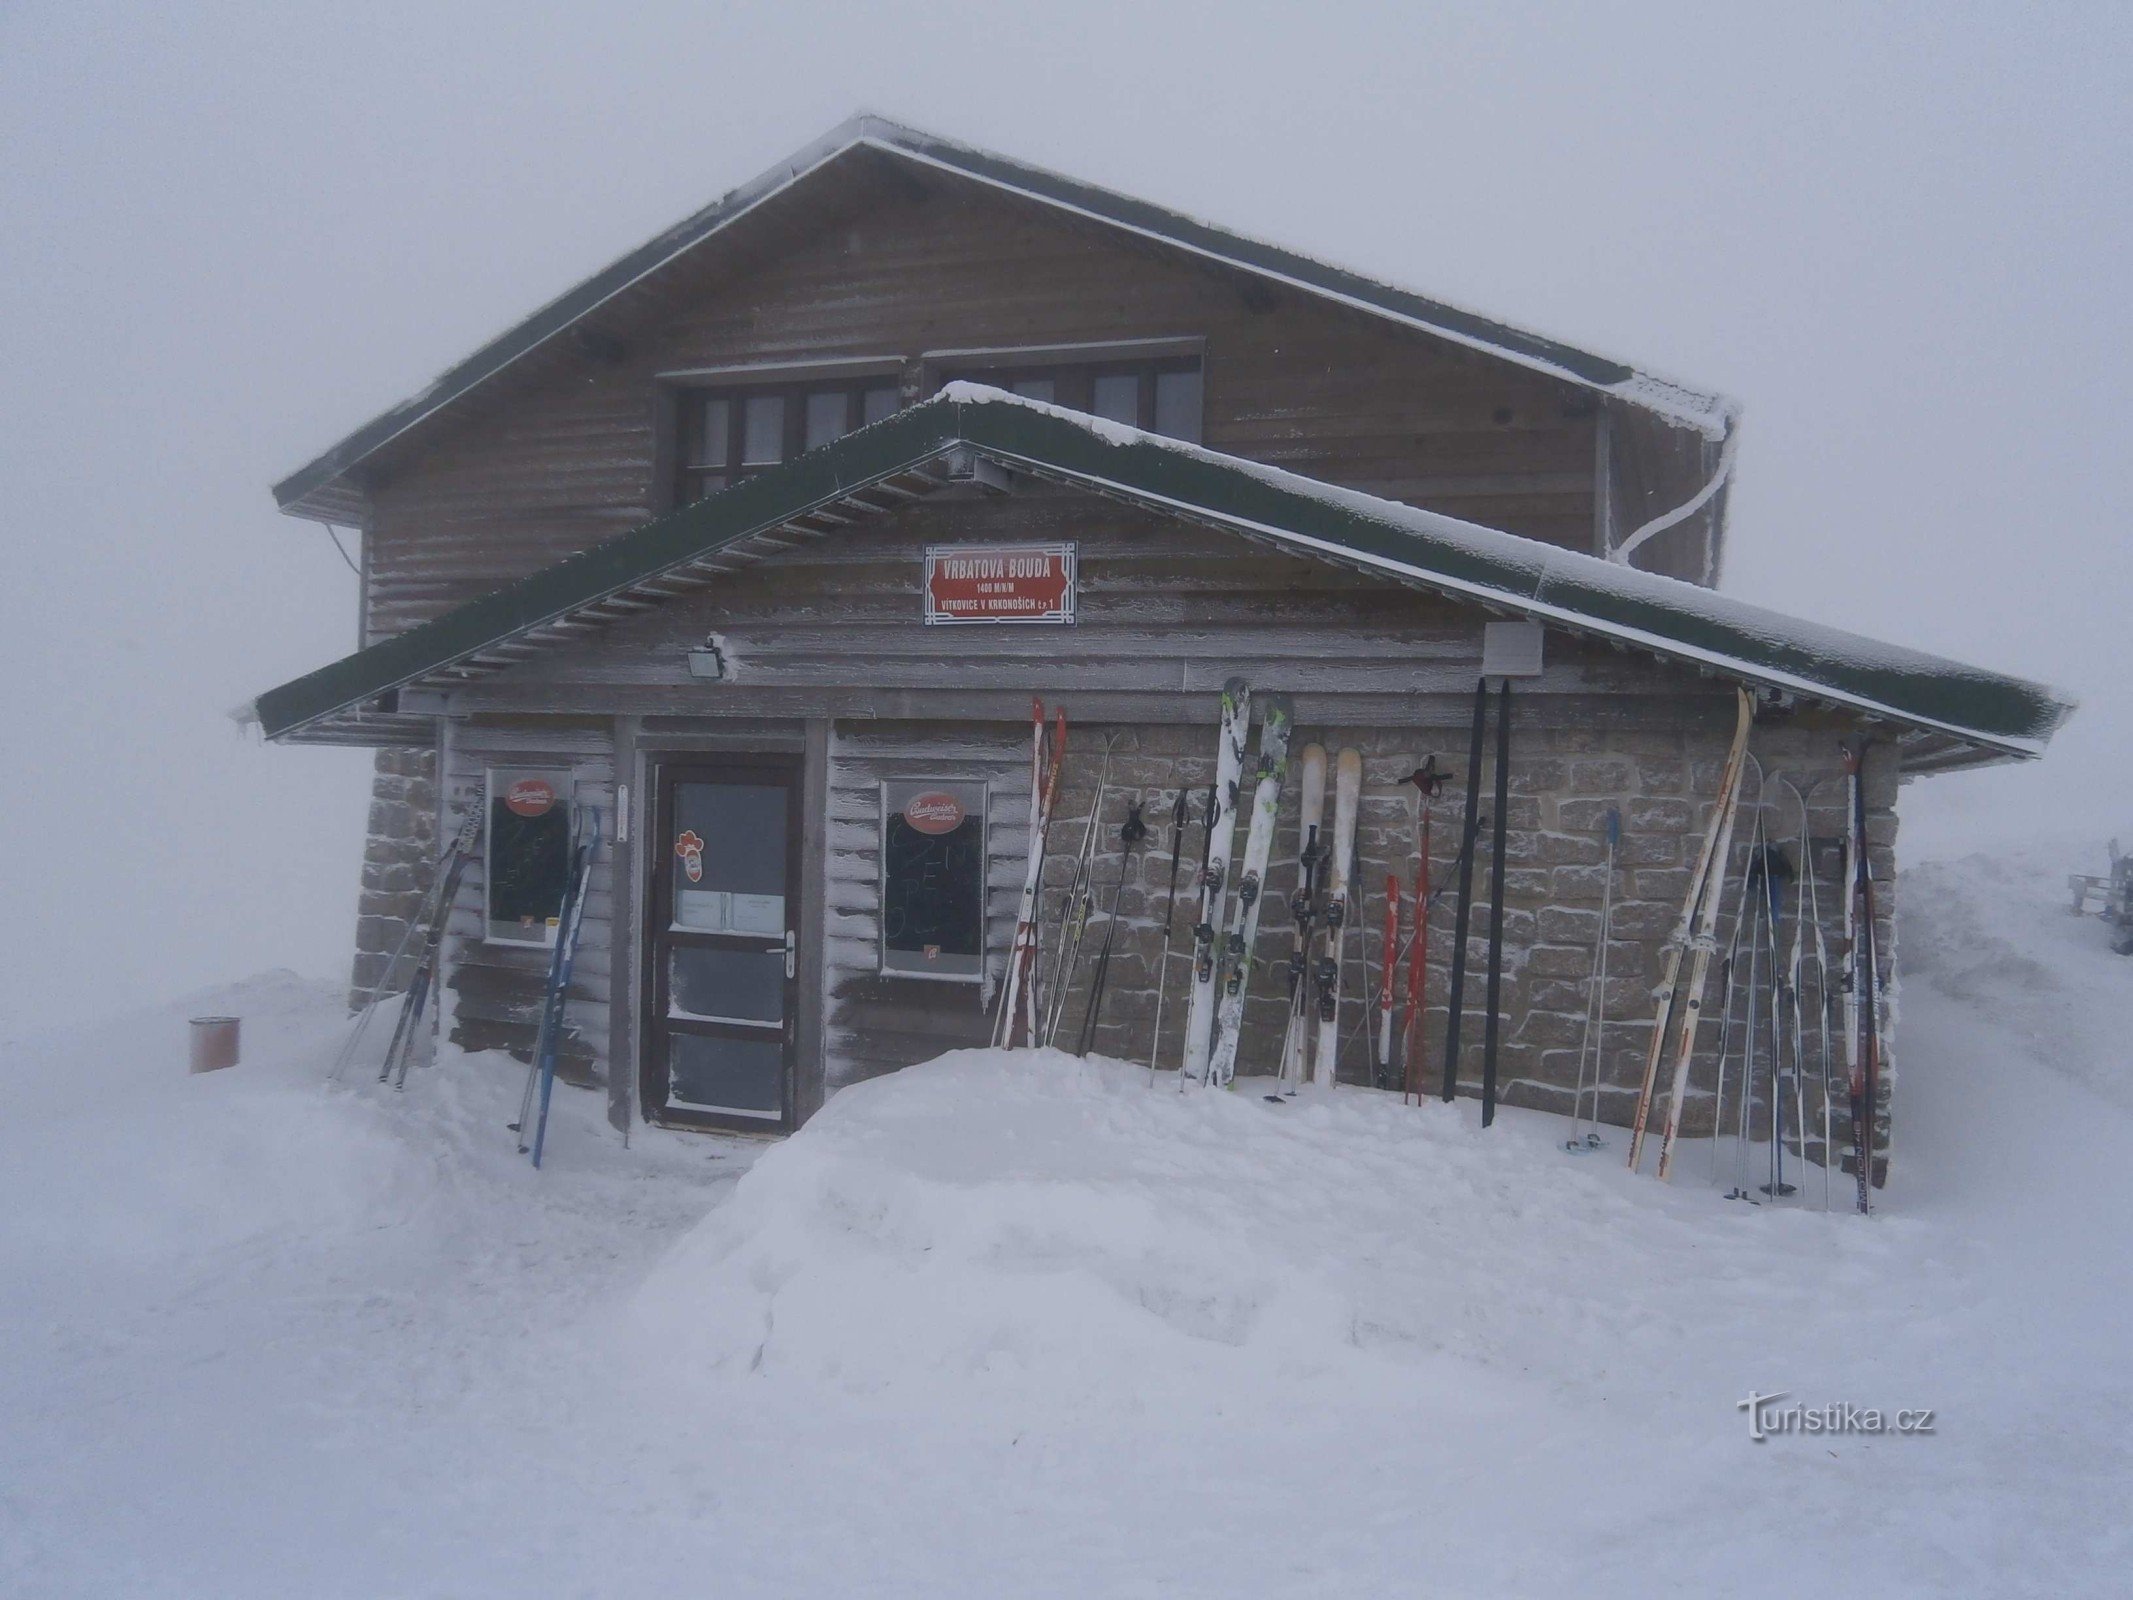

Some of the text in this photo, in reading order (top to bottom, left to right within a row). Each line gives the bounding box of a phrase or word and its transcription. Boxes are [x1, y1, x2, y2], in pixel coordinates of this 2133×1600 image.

[944, 558, 1051, 580] VRBATOVA BOUDA
[977, 582, 993, 594] 1400
[941, 597, 979, 611] VÍTKOVICE
[980, 599, 986, 610] V
[988, 596, 1036, 610] KRKONOŠÍCH
[1049, 598, 1054, 610] 1
